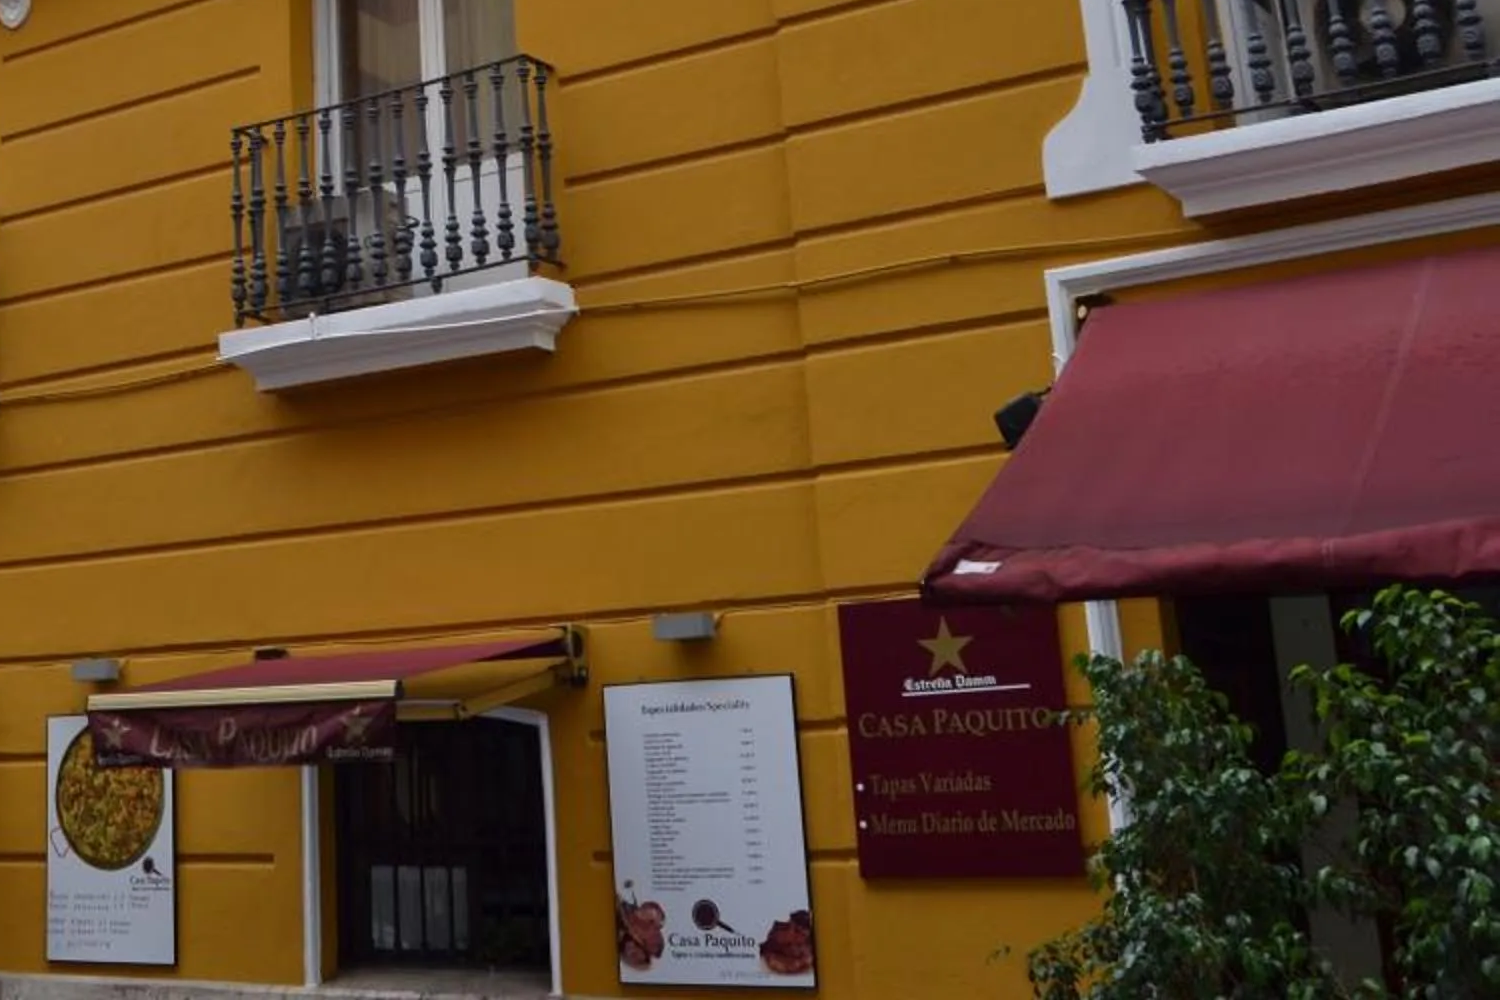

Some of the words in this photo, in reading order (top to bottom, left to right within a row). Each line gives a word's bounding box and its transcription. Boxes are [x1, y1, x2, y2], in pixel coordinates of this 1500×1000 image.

[903, 677, 953, 691] Estrella
[955, 674, 997, 688] Damm
[858, 712, 926, 738] CASA
[933, 706, 1050, 737] PAQUITO
[870, 773, 917, 801] Tapas
[918, 771, 992, 795] Variadas
[922, 810, 974, 833] Diario
[978, 810, 997, 832] de
[1001, 807, 1076, 832] Mercado
[668, 933, 700, 948] Casa
[705, 933, 756, 953] Paquito
